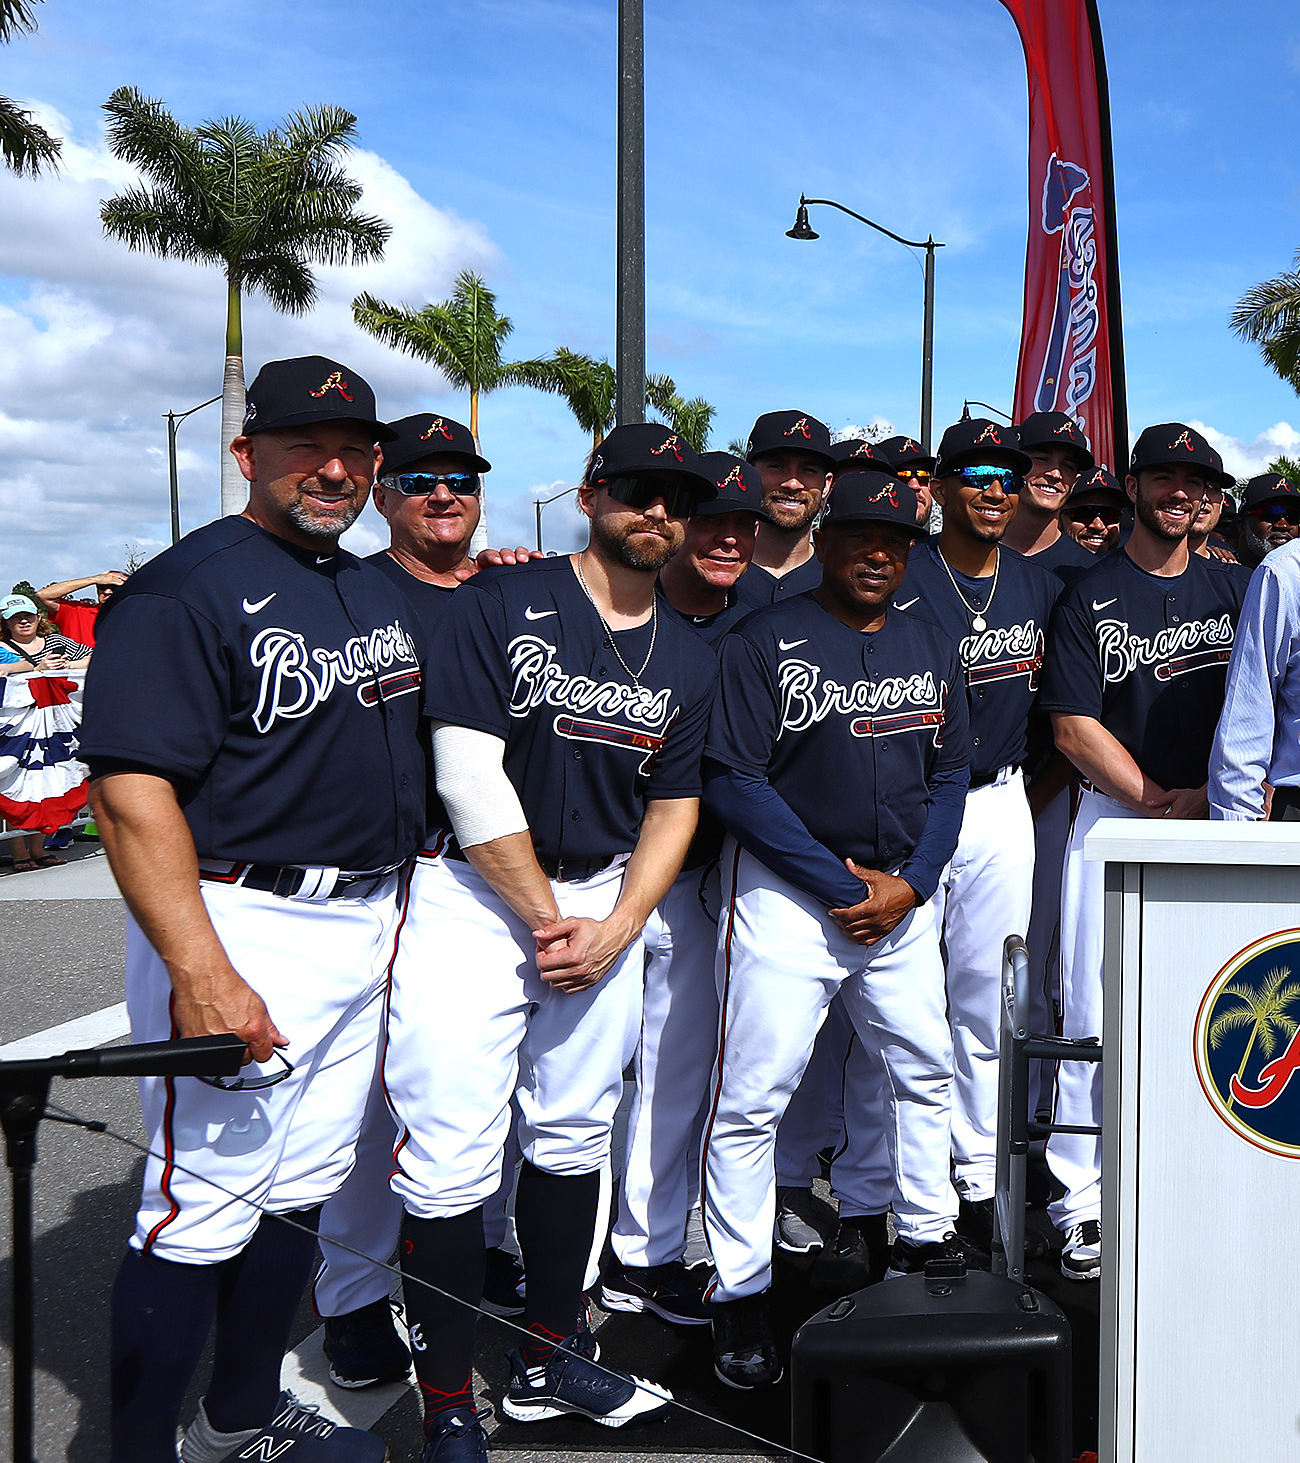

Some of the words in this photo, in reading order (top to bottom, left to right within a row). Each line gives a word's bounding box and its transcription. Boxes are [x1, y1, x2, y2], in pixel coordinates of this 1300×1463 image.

[507, 634, 672, 728] Braves
[959, 620, 1034, 667] aves
[1096, 614, 1235, 693] Braves
[775, 658, 938, 742] Braves
[238, 1435, 296, 1463] N
